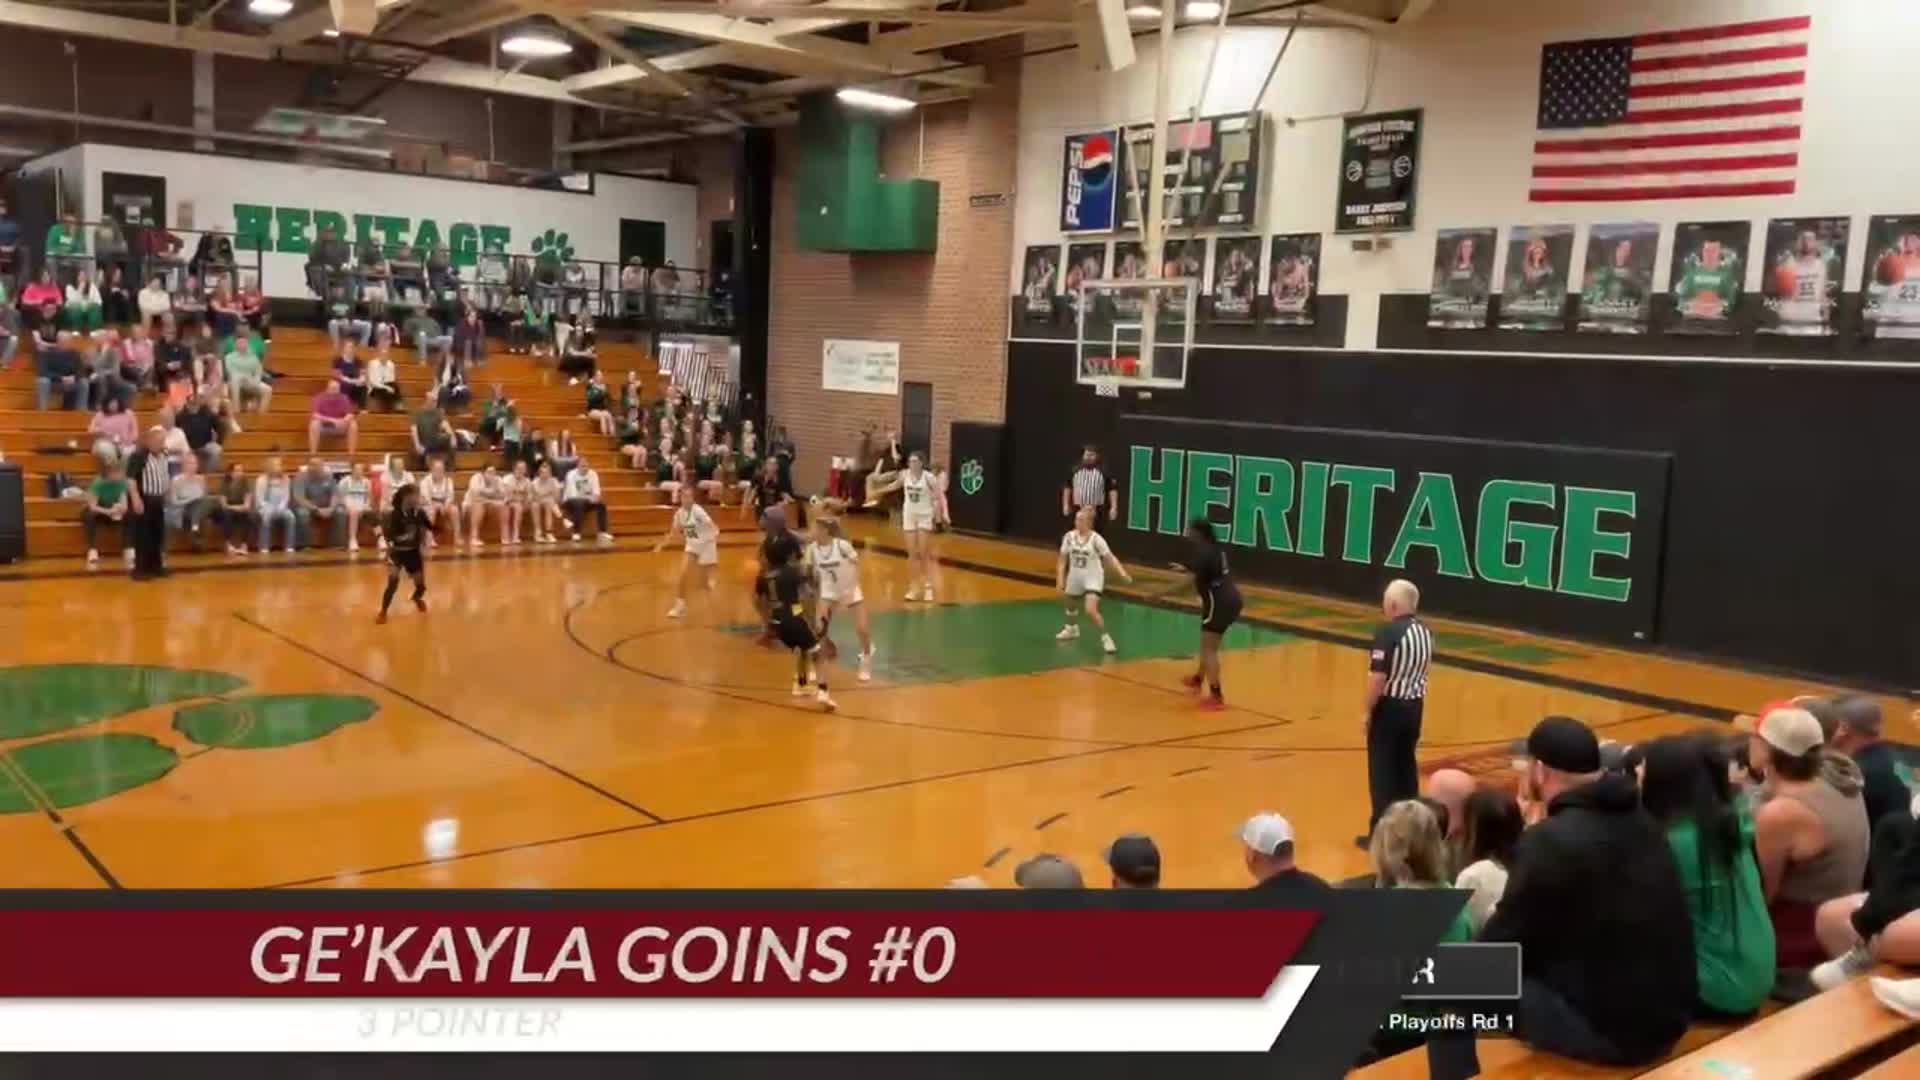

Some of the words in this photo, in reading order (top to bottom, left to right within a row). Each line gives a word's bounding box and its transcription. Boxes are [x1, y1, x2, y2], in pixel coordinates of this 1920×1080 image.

[1066, 141, 1084, 226] PEPSI
[233, 203, 511, 269] HERITAGE
[1127, 445, 1637, 602] HERITAGE
